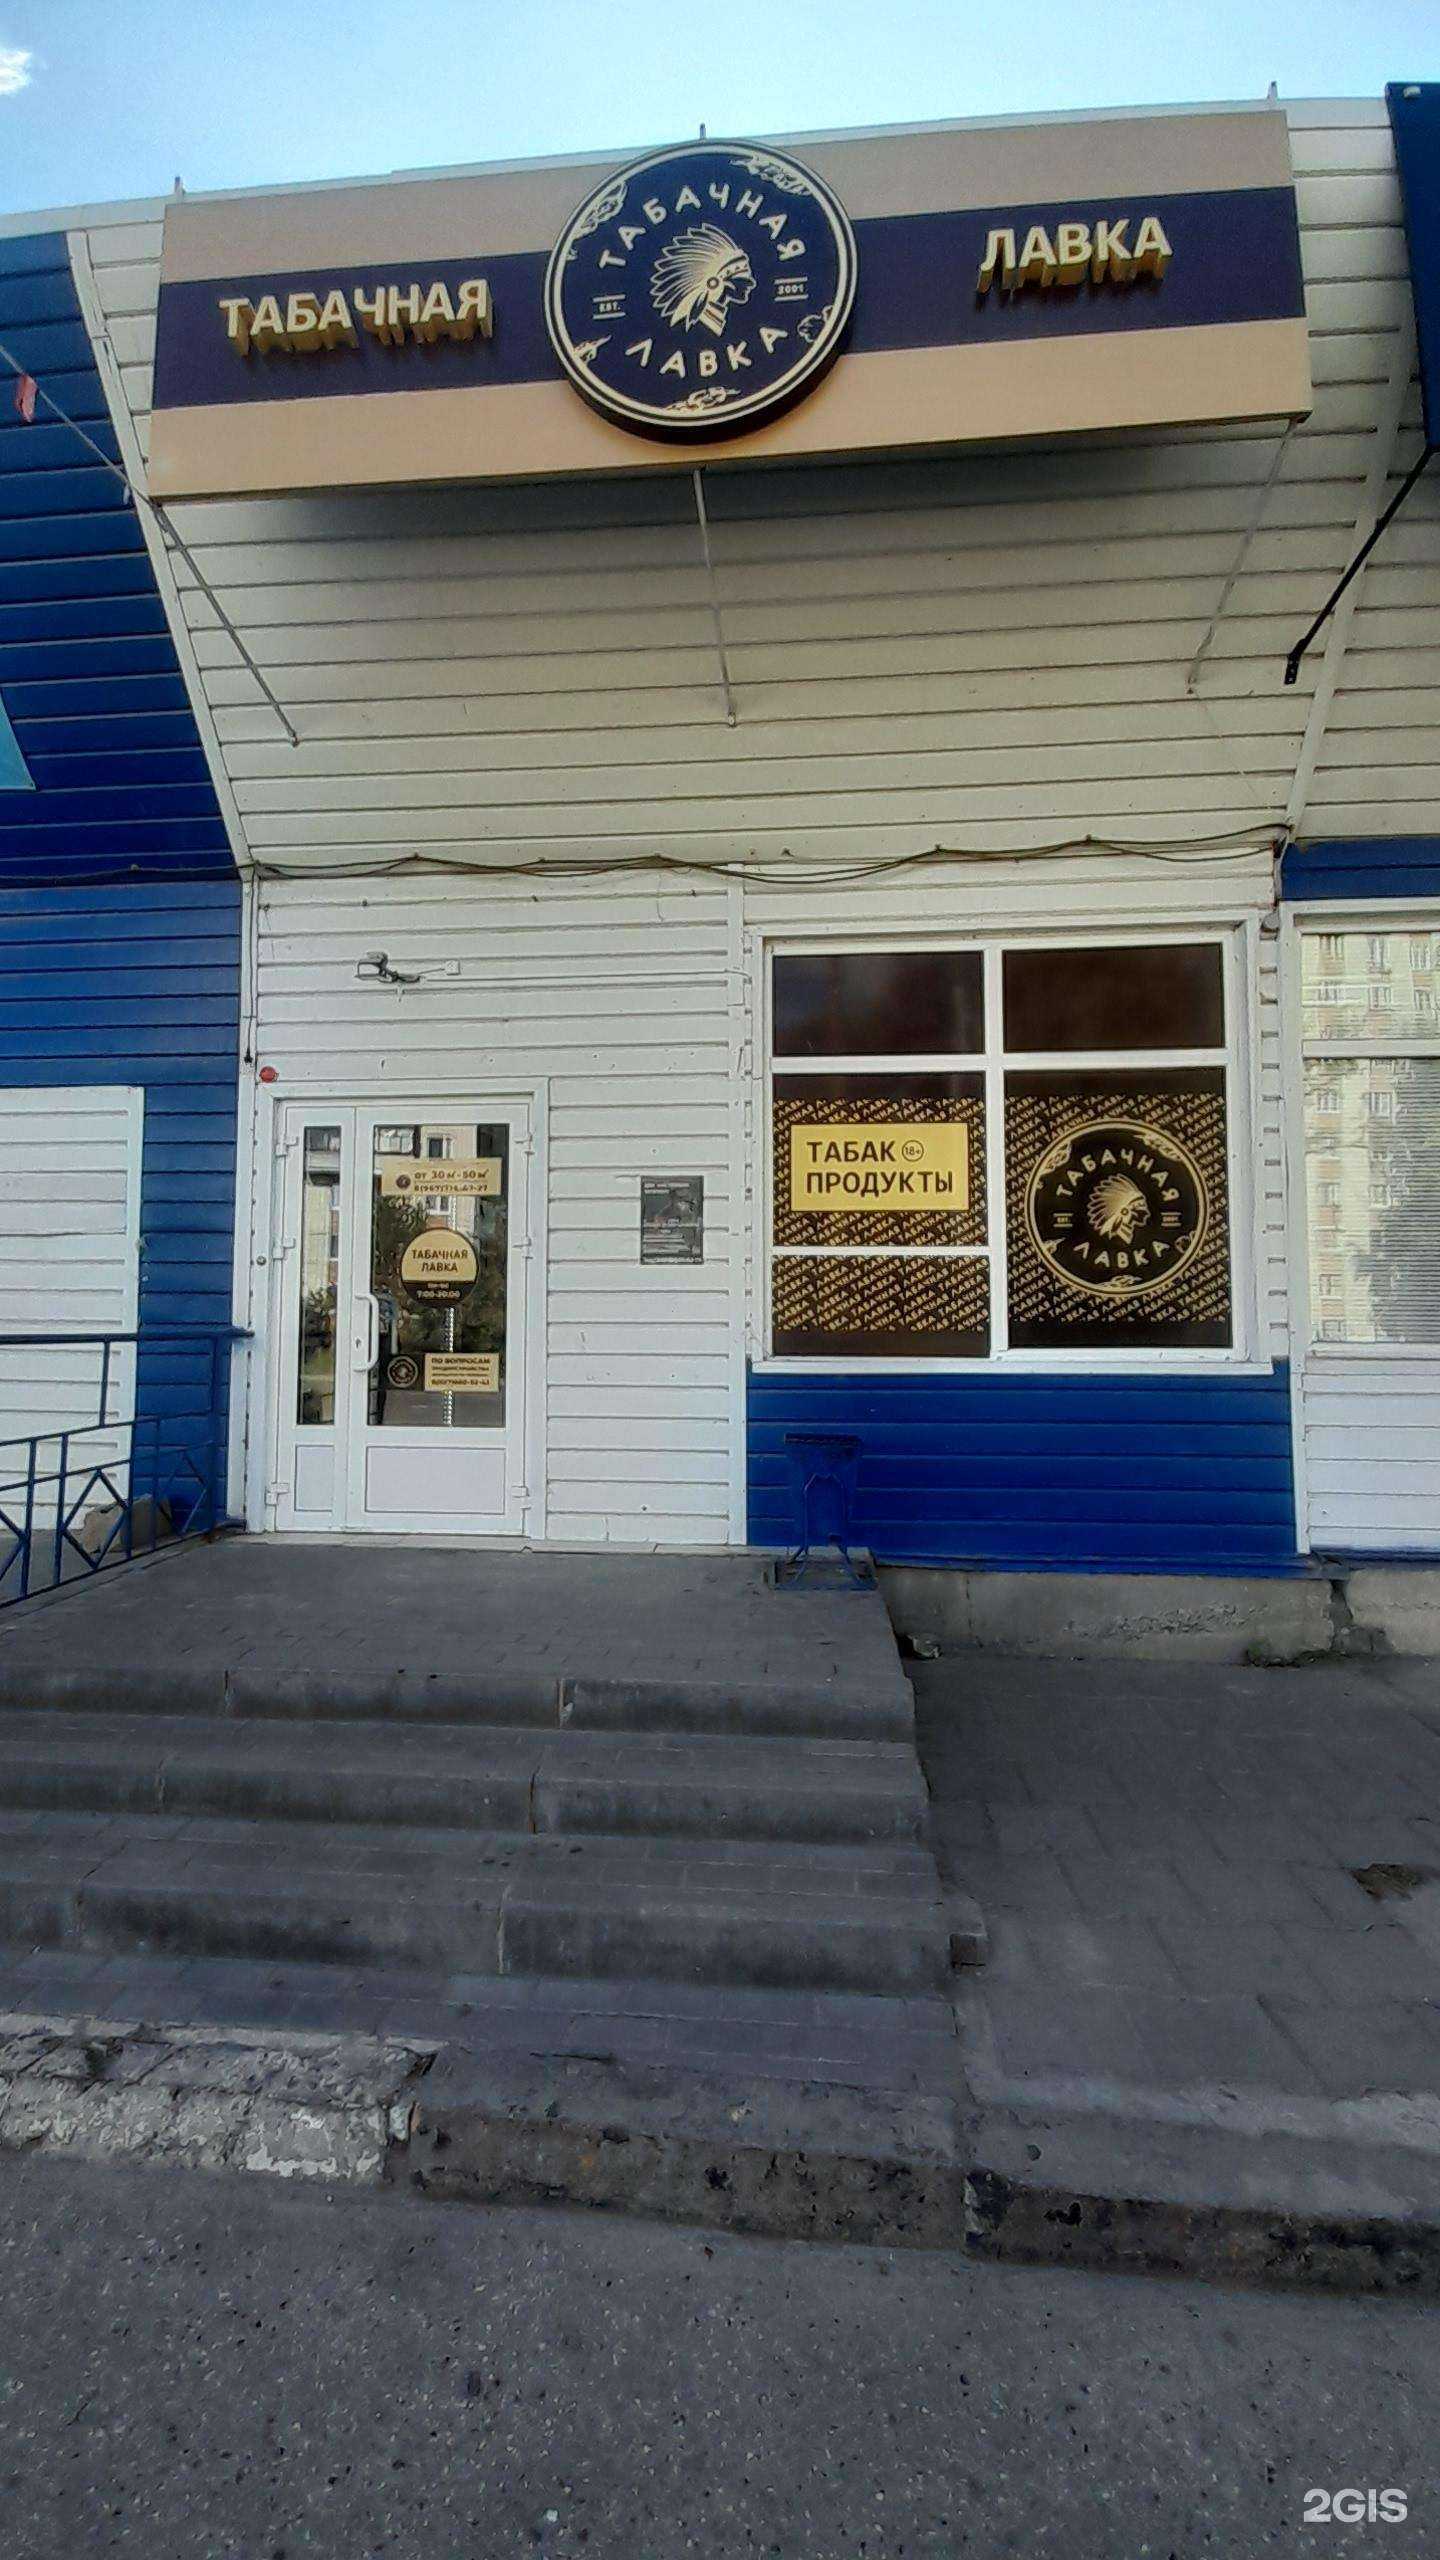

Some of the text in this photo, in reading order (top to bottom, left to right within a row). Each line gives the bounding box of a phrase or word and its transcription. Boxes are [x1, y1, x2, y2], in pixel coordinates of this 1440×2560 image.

[598, 182, 806, 269] ТАБАЧНАЯ
[219, 217, 1174, 338] ТАБАЧНАЯ ЛАВКА
[625, 326, 788, 378] ЛАВКА
[806, 1141, 897, 1162] ТАБАК
[806, 1171, 953, 1197] ПРОДУКТЫ
[1056, 1148, 1180, 1201] ТАБАЧНАЯ
[411, 1249, 468, 1260] ТАБАЧНАЯ
[421, 1263, 458, 1273] ЛАВКА
[1073, 1240, 1170, 1268] ЛАВКА
